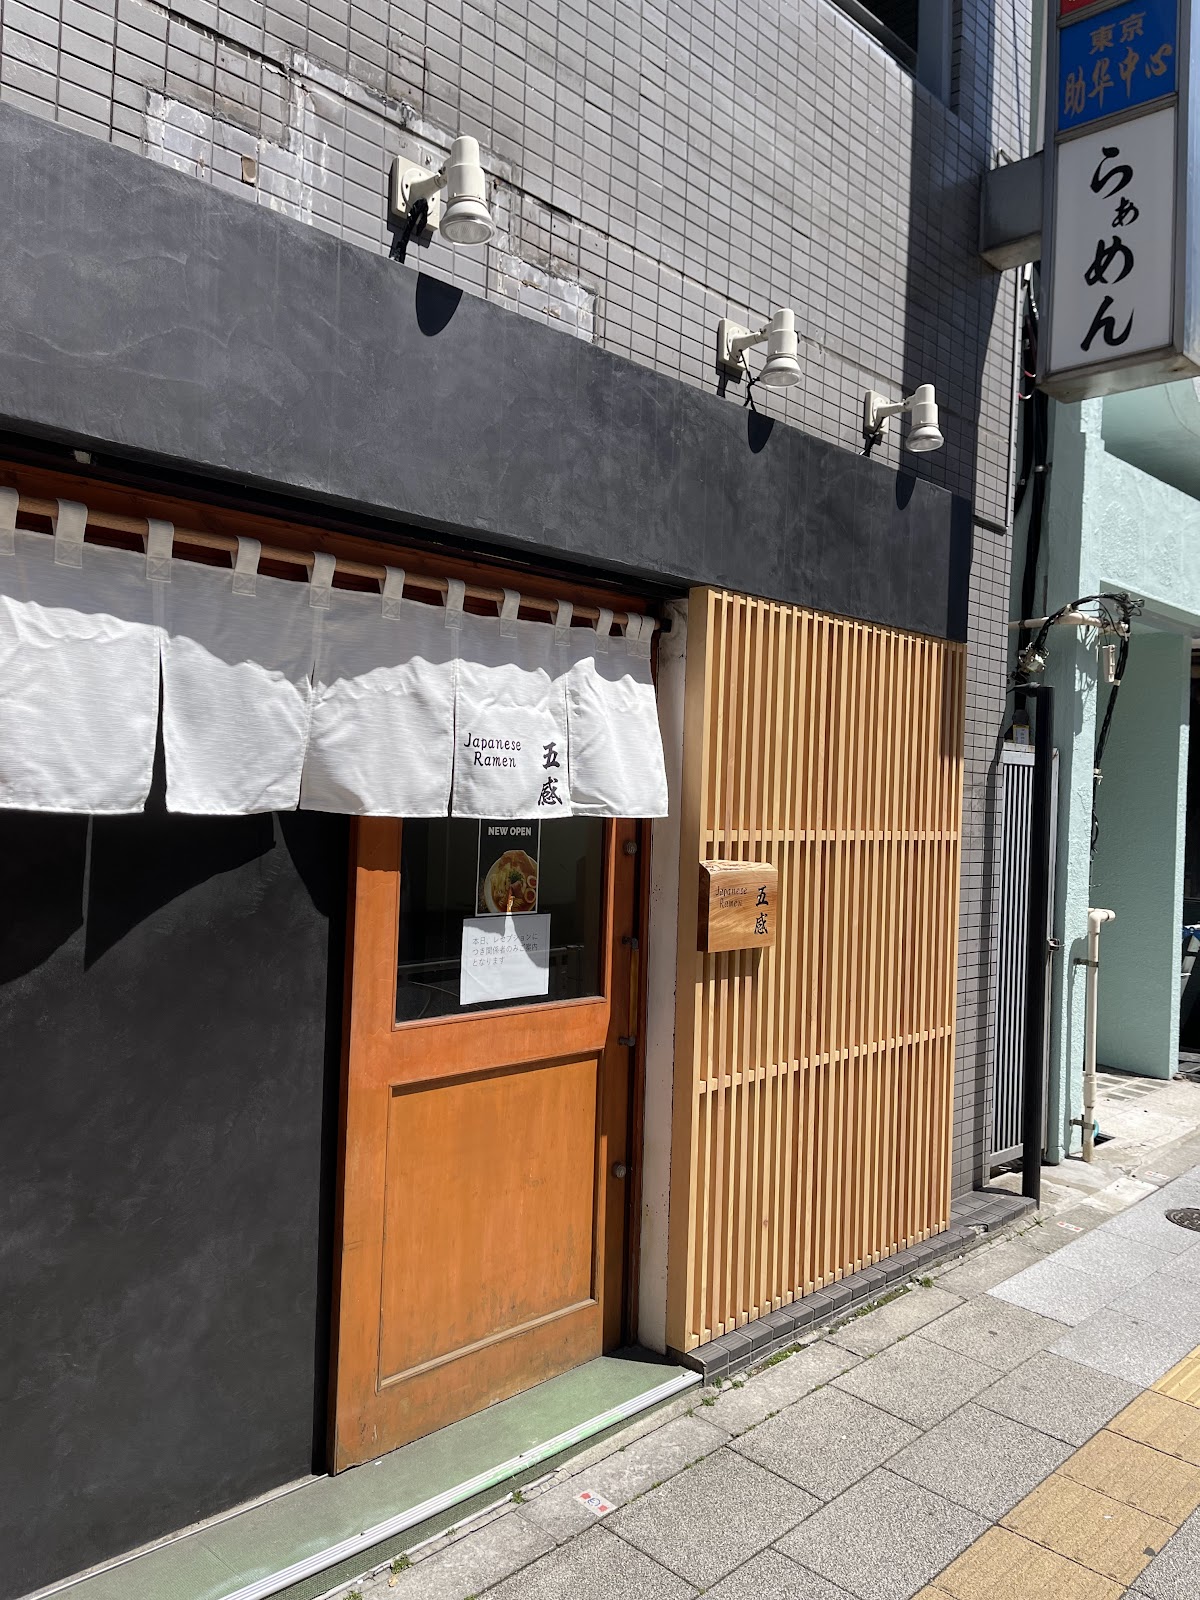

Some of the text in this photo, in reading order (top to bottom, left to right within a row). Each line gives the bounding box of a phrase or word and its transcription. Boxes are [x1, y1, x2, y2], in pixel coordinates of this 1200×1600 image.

[1088, 11, 1147, 55] 東京
[463, 732, 522, 751] Japanese
[473, 751, 517, 768] Ramen
[537, 741, 563, 806] 五感
[487, 826, 532, 836] NEW OPEN
[715, 885, 748, 897] Japanese
[719, 898, 743, 909] Ramen
[754, 884, 769, 934] 五感
